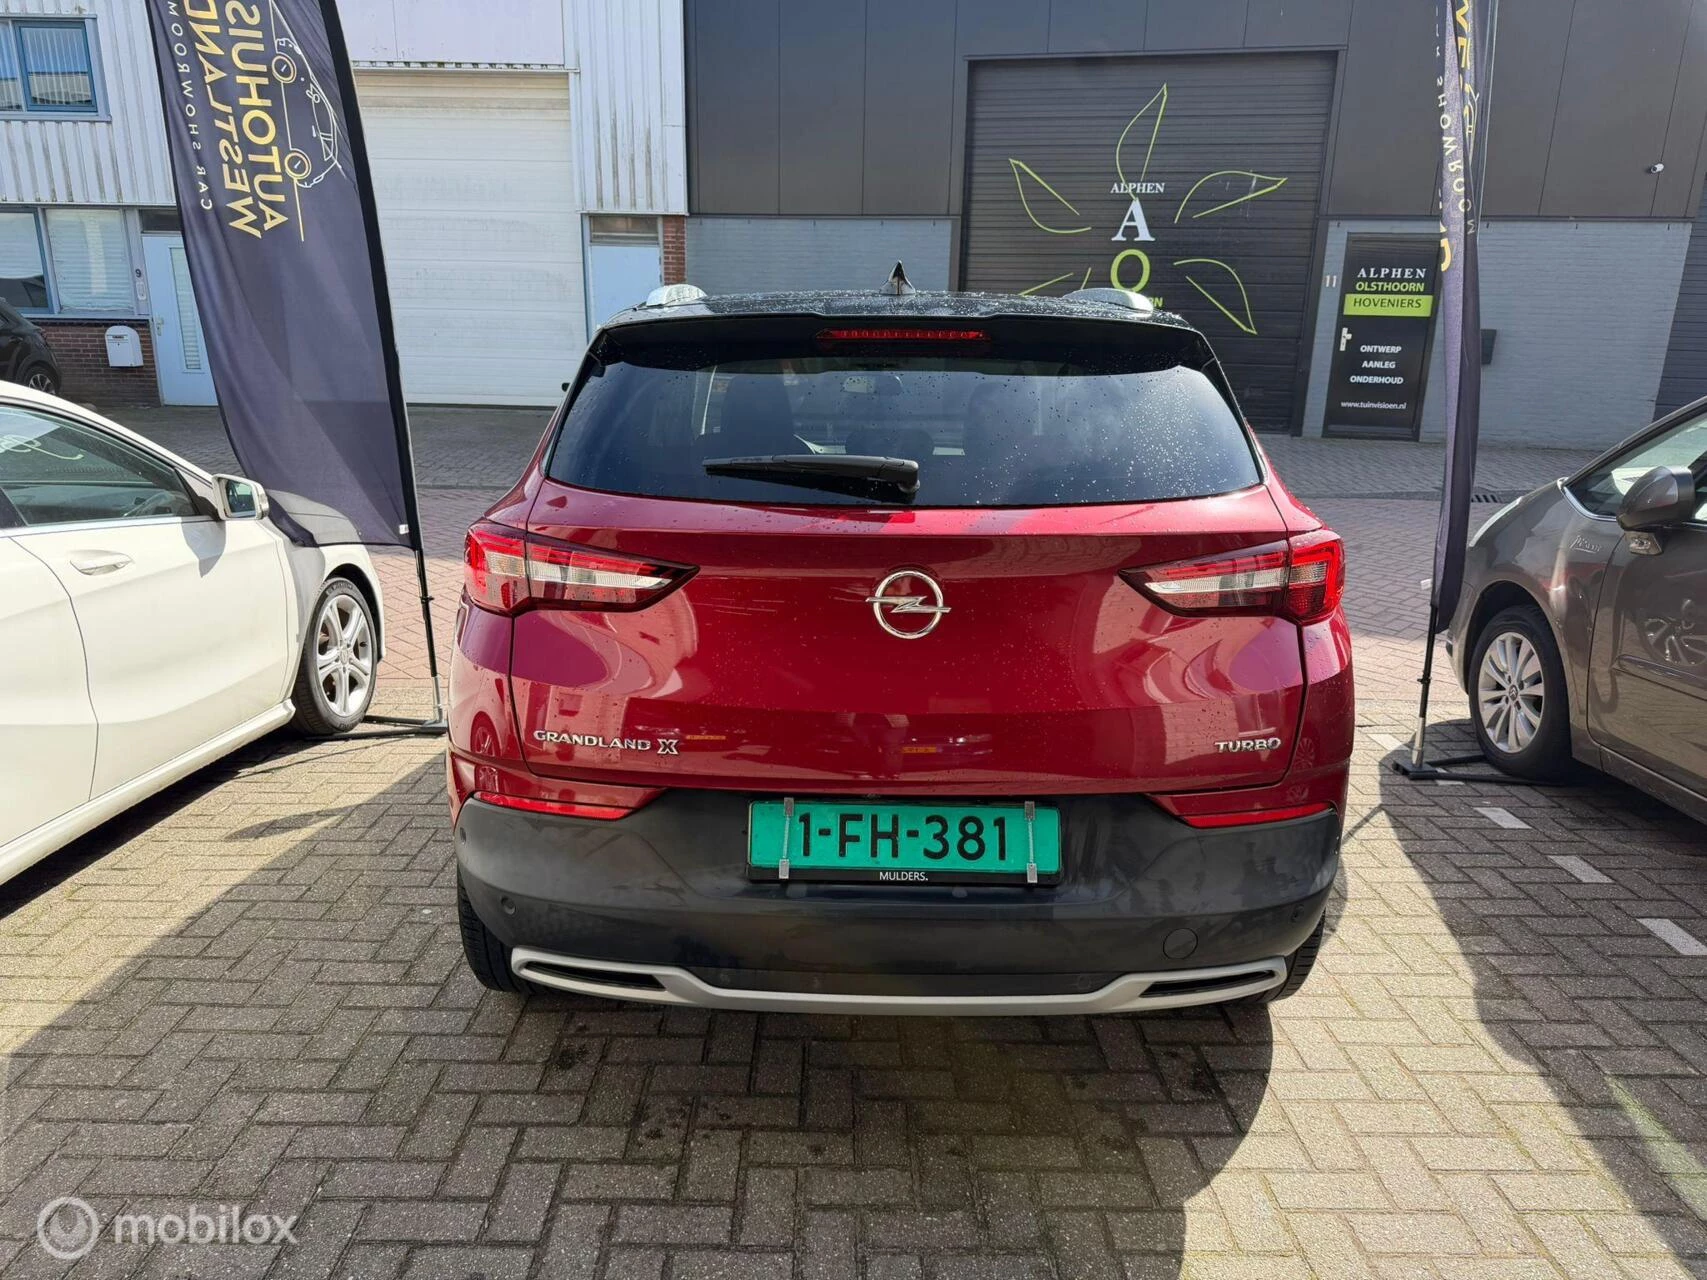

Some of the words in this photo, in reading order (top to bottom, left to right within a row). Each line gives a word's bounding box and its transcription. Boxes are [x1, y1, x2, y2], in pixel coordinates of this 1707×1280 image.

[1110, 182, 1166, 194] ALPHEN
[1111, 197, 1155, 242] A
[135, 268, 142, 278] 9
[1356, 267, 1427, 279] ALPHEN
[1325, 275, 1338, 288] 11
[1355, 281, 1425, 292] OLSTHOORN
[1353, 298, 1422, 308] HOVENIERS
[1360, 345, 1402, 354] ONTWERP
[1361, 361, 1396, 369] AANLEG
[1349, 375, 1404, 385] ONDERHOUD
[532, 730, 652, 751] GRANDLAND
[657, 738, 680, 755] X
[1214, 737, 1281, 753] TURBO
[798, 811, 1007, 861] 1-FH-381
